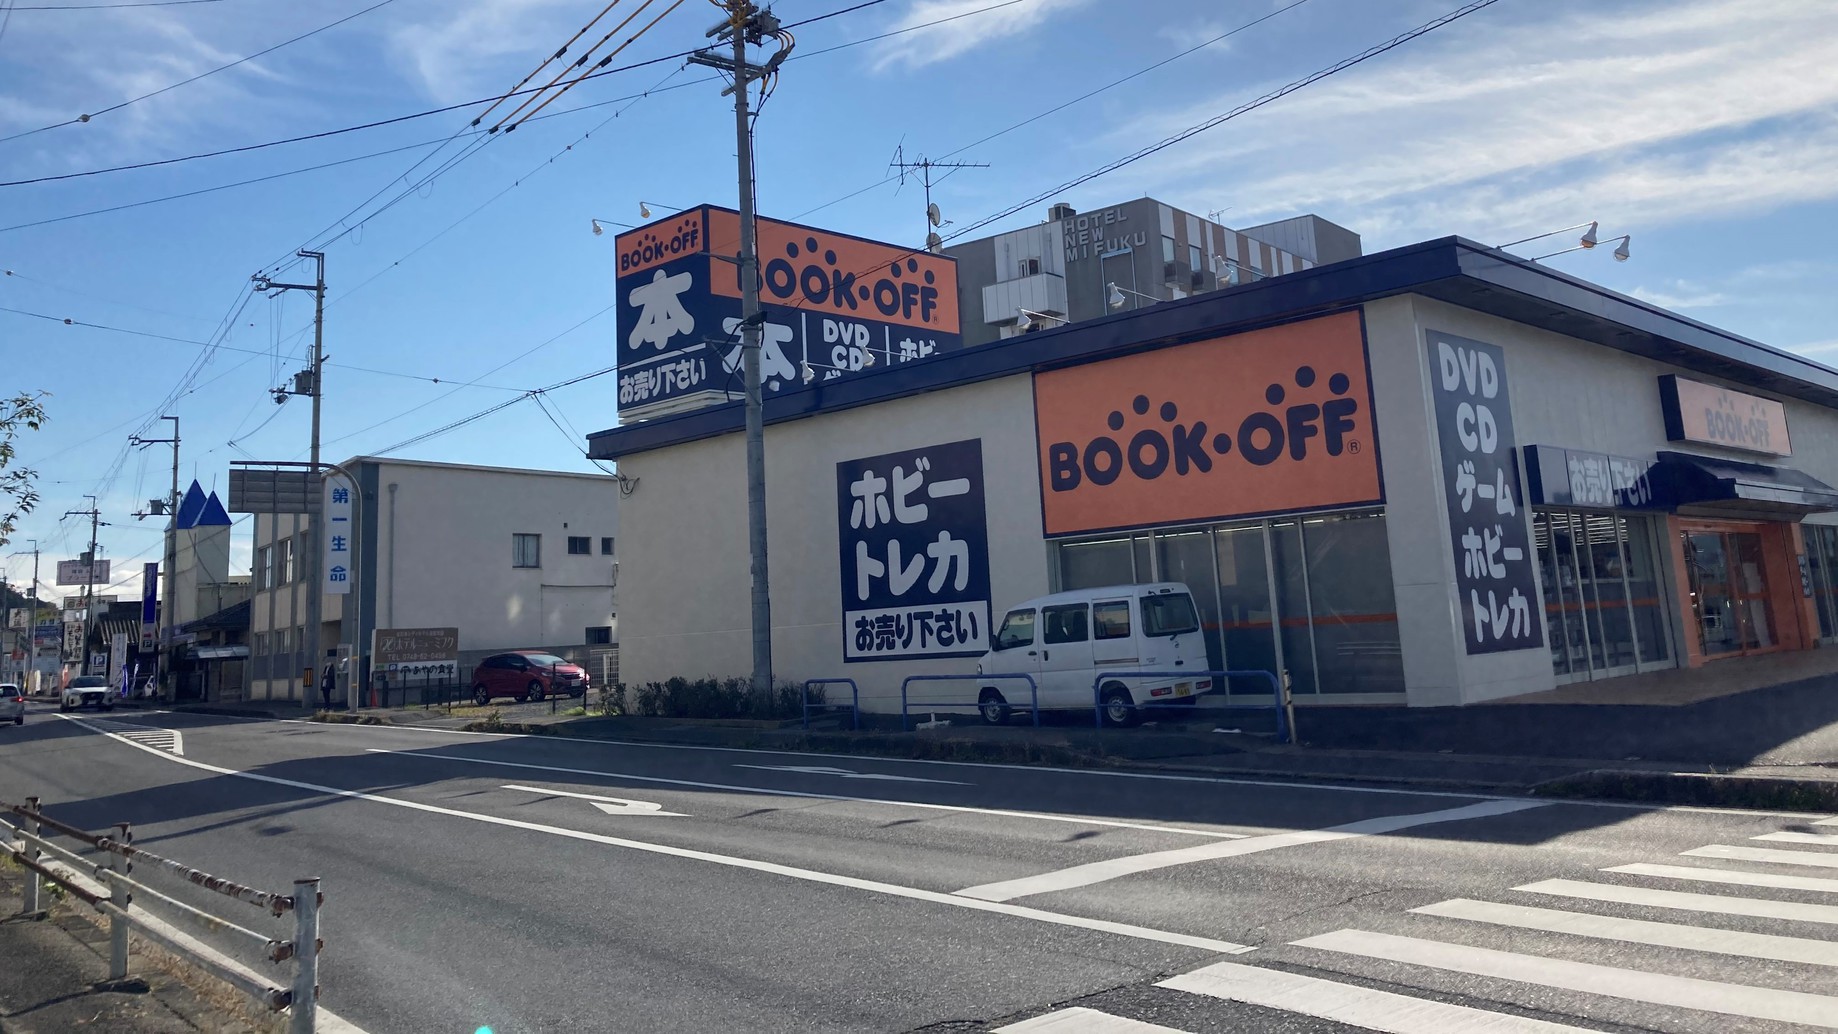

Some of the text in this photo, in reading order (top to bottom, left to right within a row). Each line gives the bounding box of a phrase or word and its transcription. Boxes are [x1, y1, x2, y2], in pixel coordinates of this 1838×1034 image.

[1064, 208, 1128, 234] HOTEL
[1065, 227, 1104, 248] NEW
[629, 269, 695, 349] 本
[823, 319, 870, 347] DVD
[722, 317, 796, 382] 本
[831, 345, 864, 371] CD
[1438, 342, 1498, 399] DVD
[620, 358, 706, 404] お売り下さい
[1456, 402, 1498, 454] CD
[850, 456, 971, 529] ホビー
[1456, 460, 1516, 516] ゲーム
[1569, 456, 1652, 506] お売り下さい
[330, 487, 349, 582] 第一生命
[1462, 525, 1523, 579] ホビー
[856, 530, 970, 601] トレカ
[855, 609, 978, 651] お売り下さい
[1471, 587, 1531, 643] トレカ
